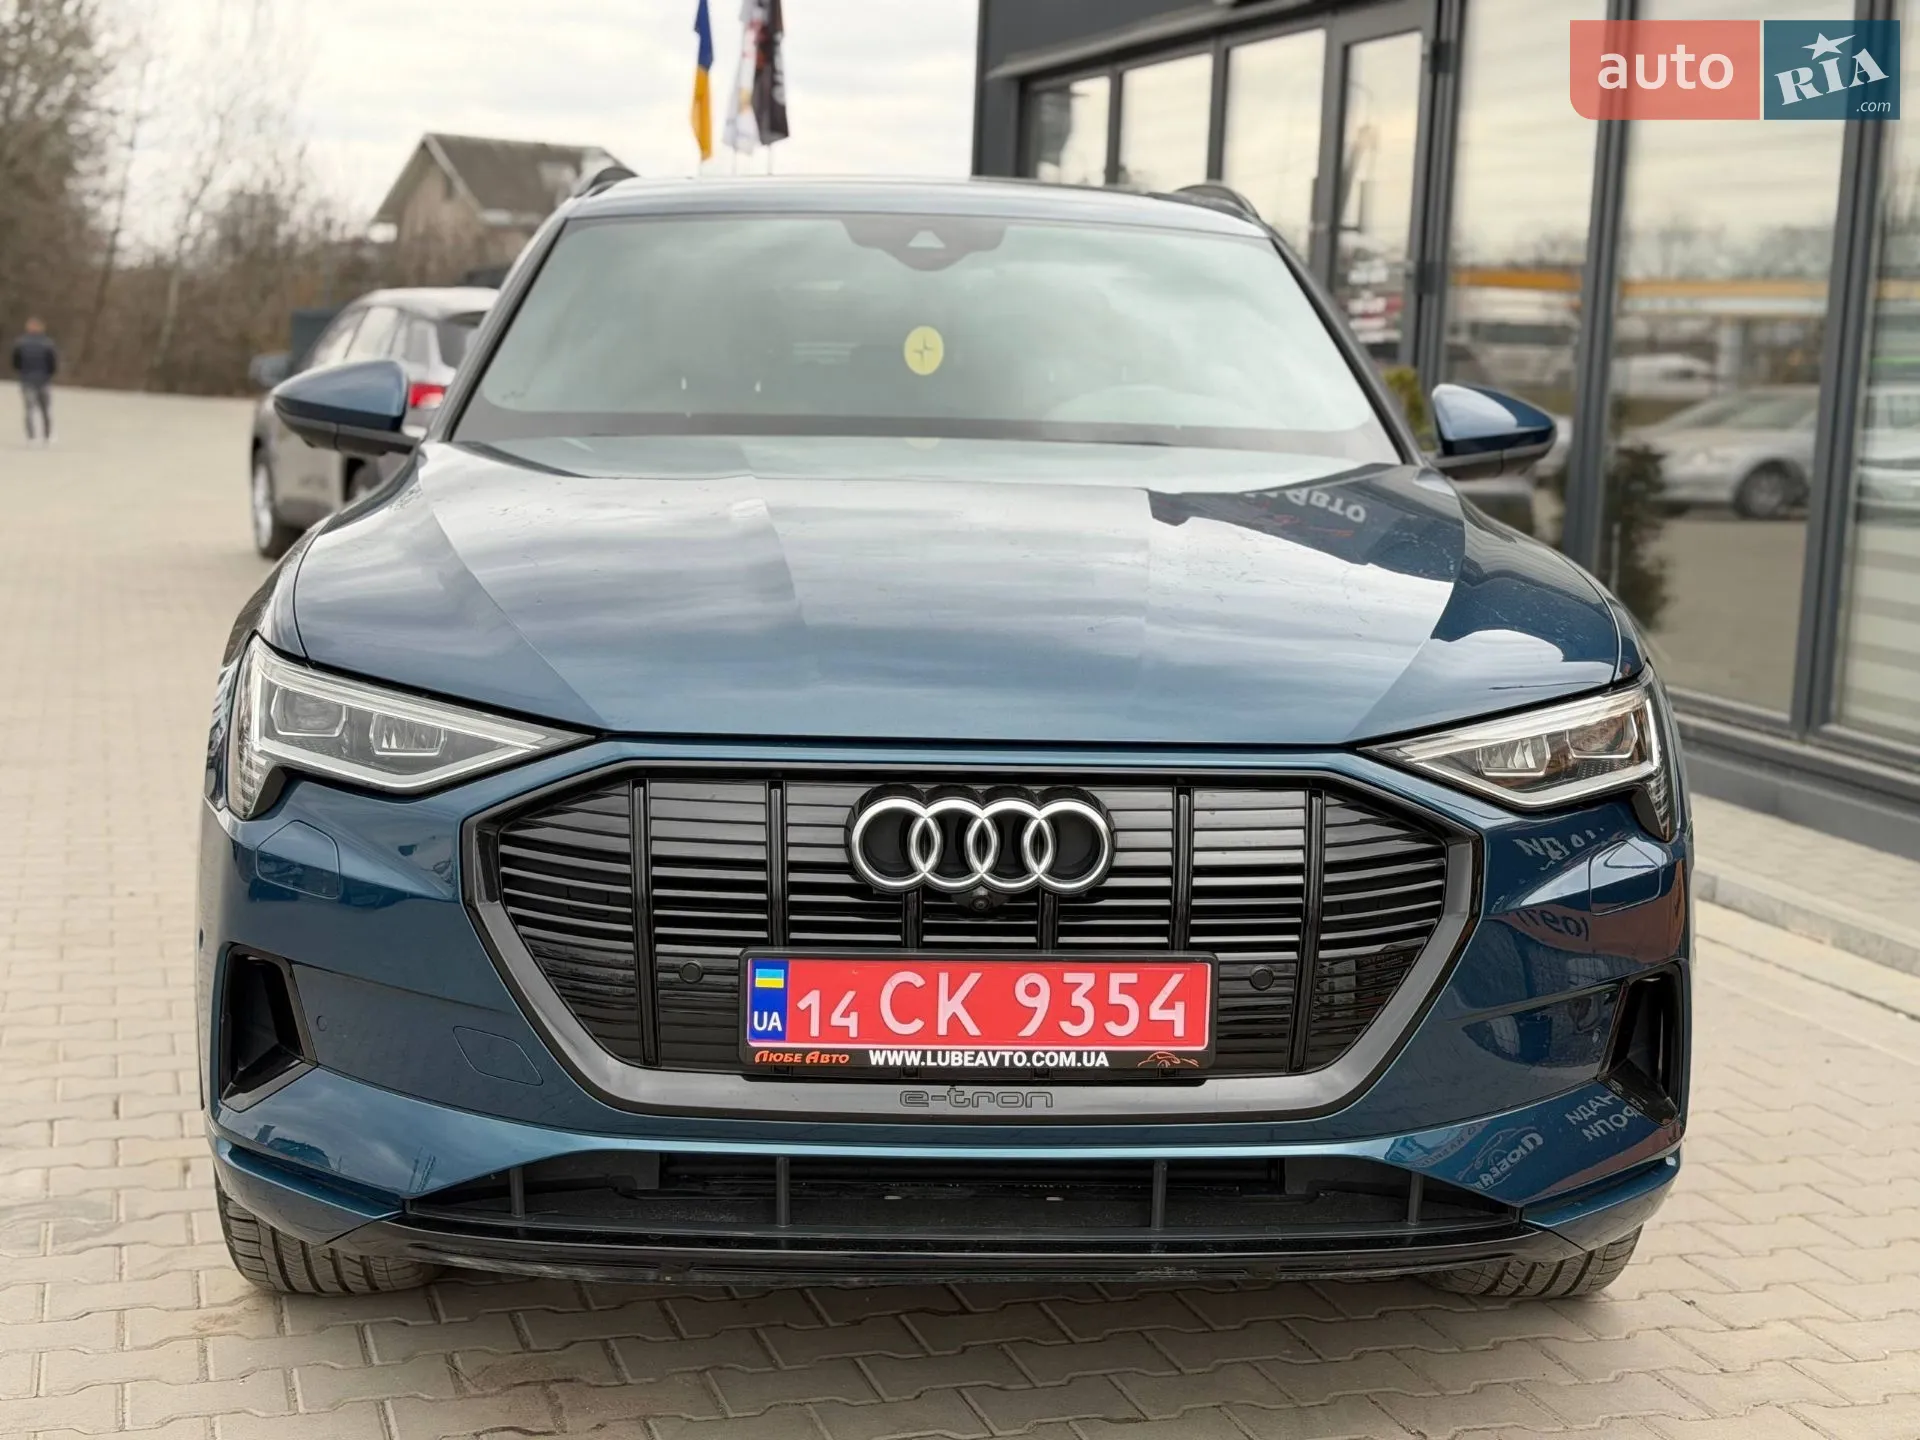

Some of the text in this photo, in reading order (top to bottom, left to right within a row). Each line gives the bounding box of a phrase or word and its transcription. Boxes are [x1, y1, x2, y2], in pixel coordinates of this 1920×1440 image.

[796, 971, 1186, 1038] 14 CK 9354
[753, 1010, 783, 1032] UA
[869, 1049, 1110, 1067] WWW.LUBEAVTO.COM.UA
[899, 1088, 1054, 1108] e-tron
